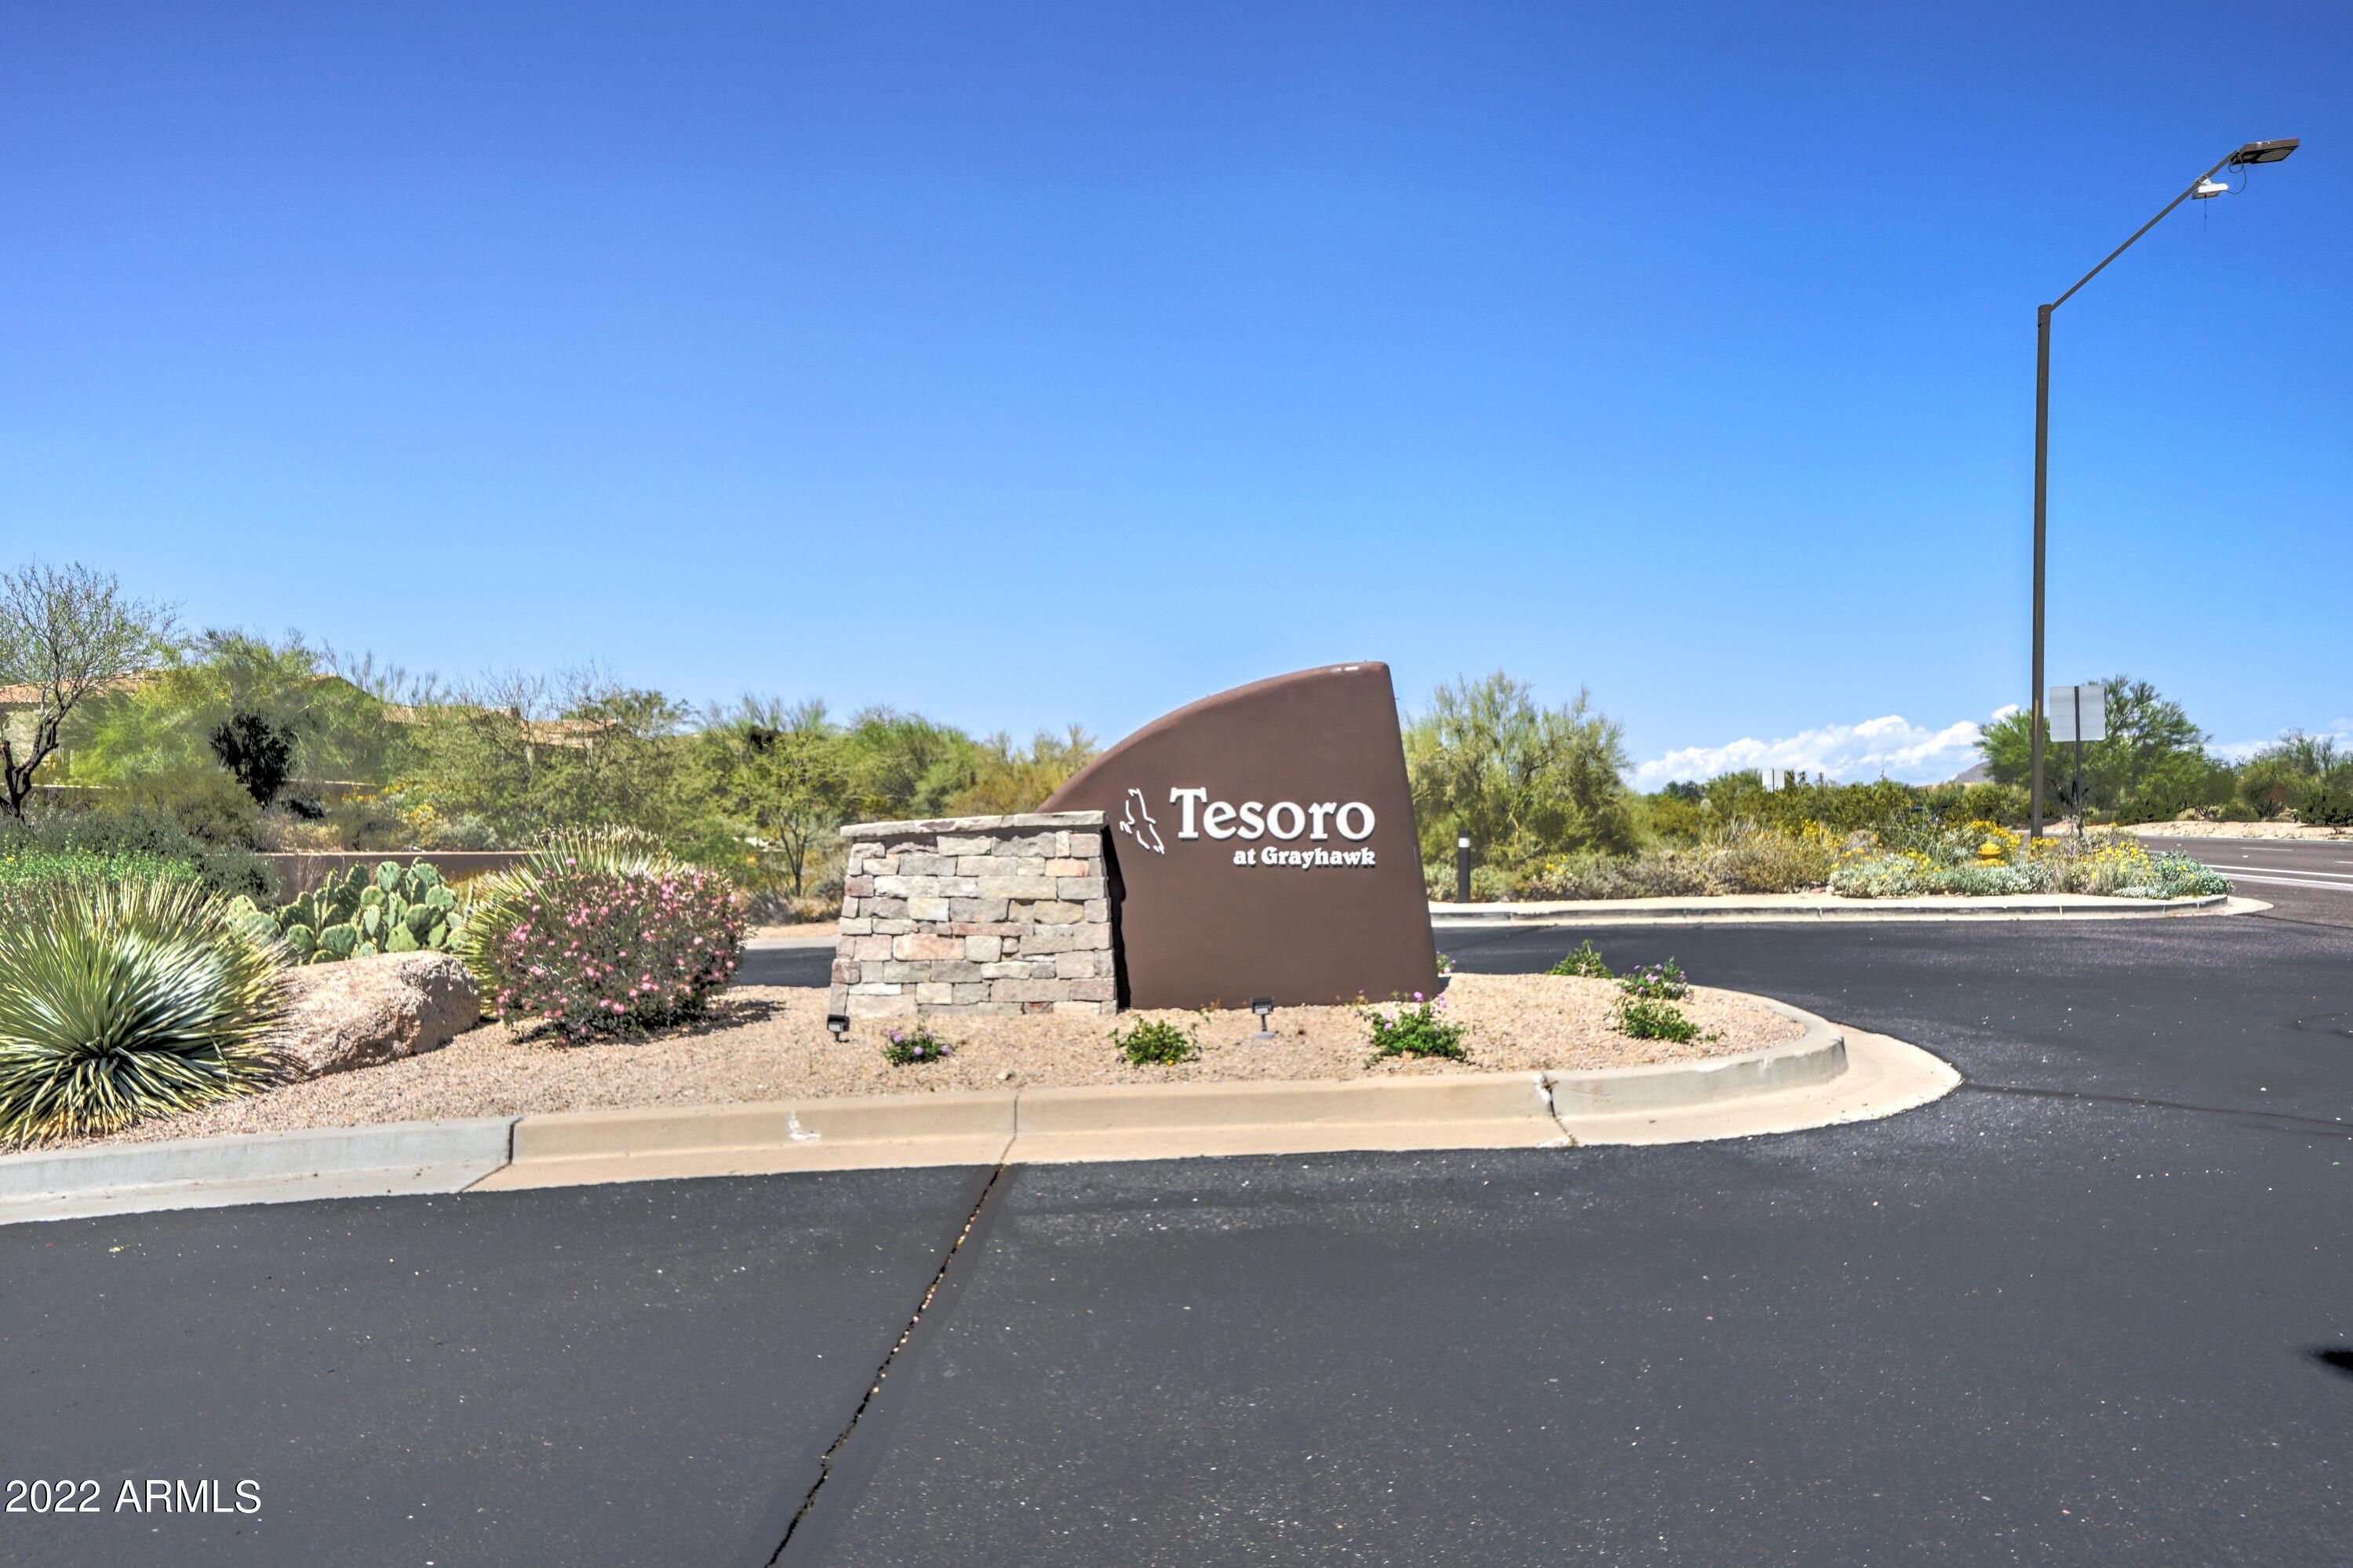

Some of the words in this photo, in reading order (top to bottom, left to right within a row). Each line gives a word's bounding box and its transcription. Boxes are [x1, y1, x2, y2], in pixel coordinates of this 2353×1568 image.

[1169, 787, 1376, 842] Tesoro
[1233, 848, 1257, 866] at
[1260, 846, 1376, 870] Grayhawk
